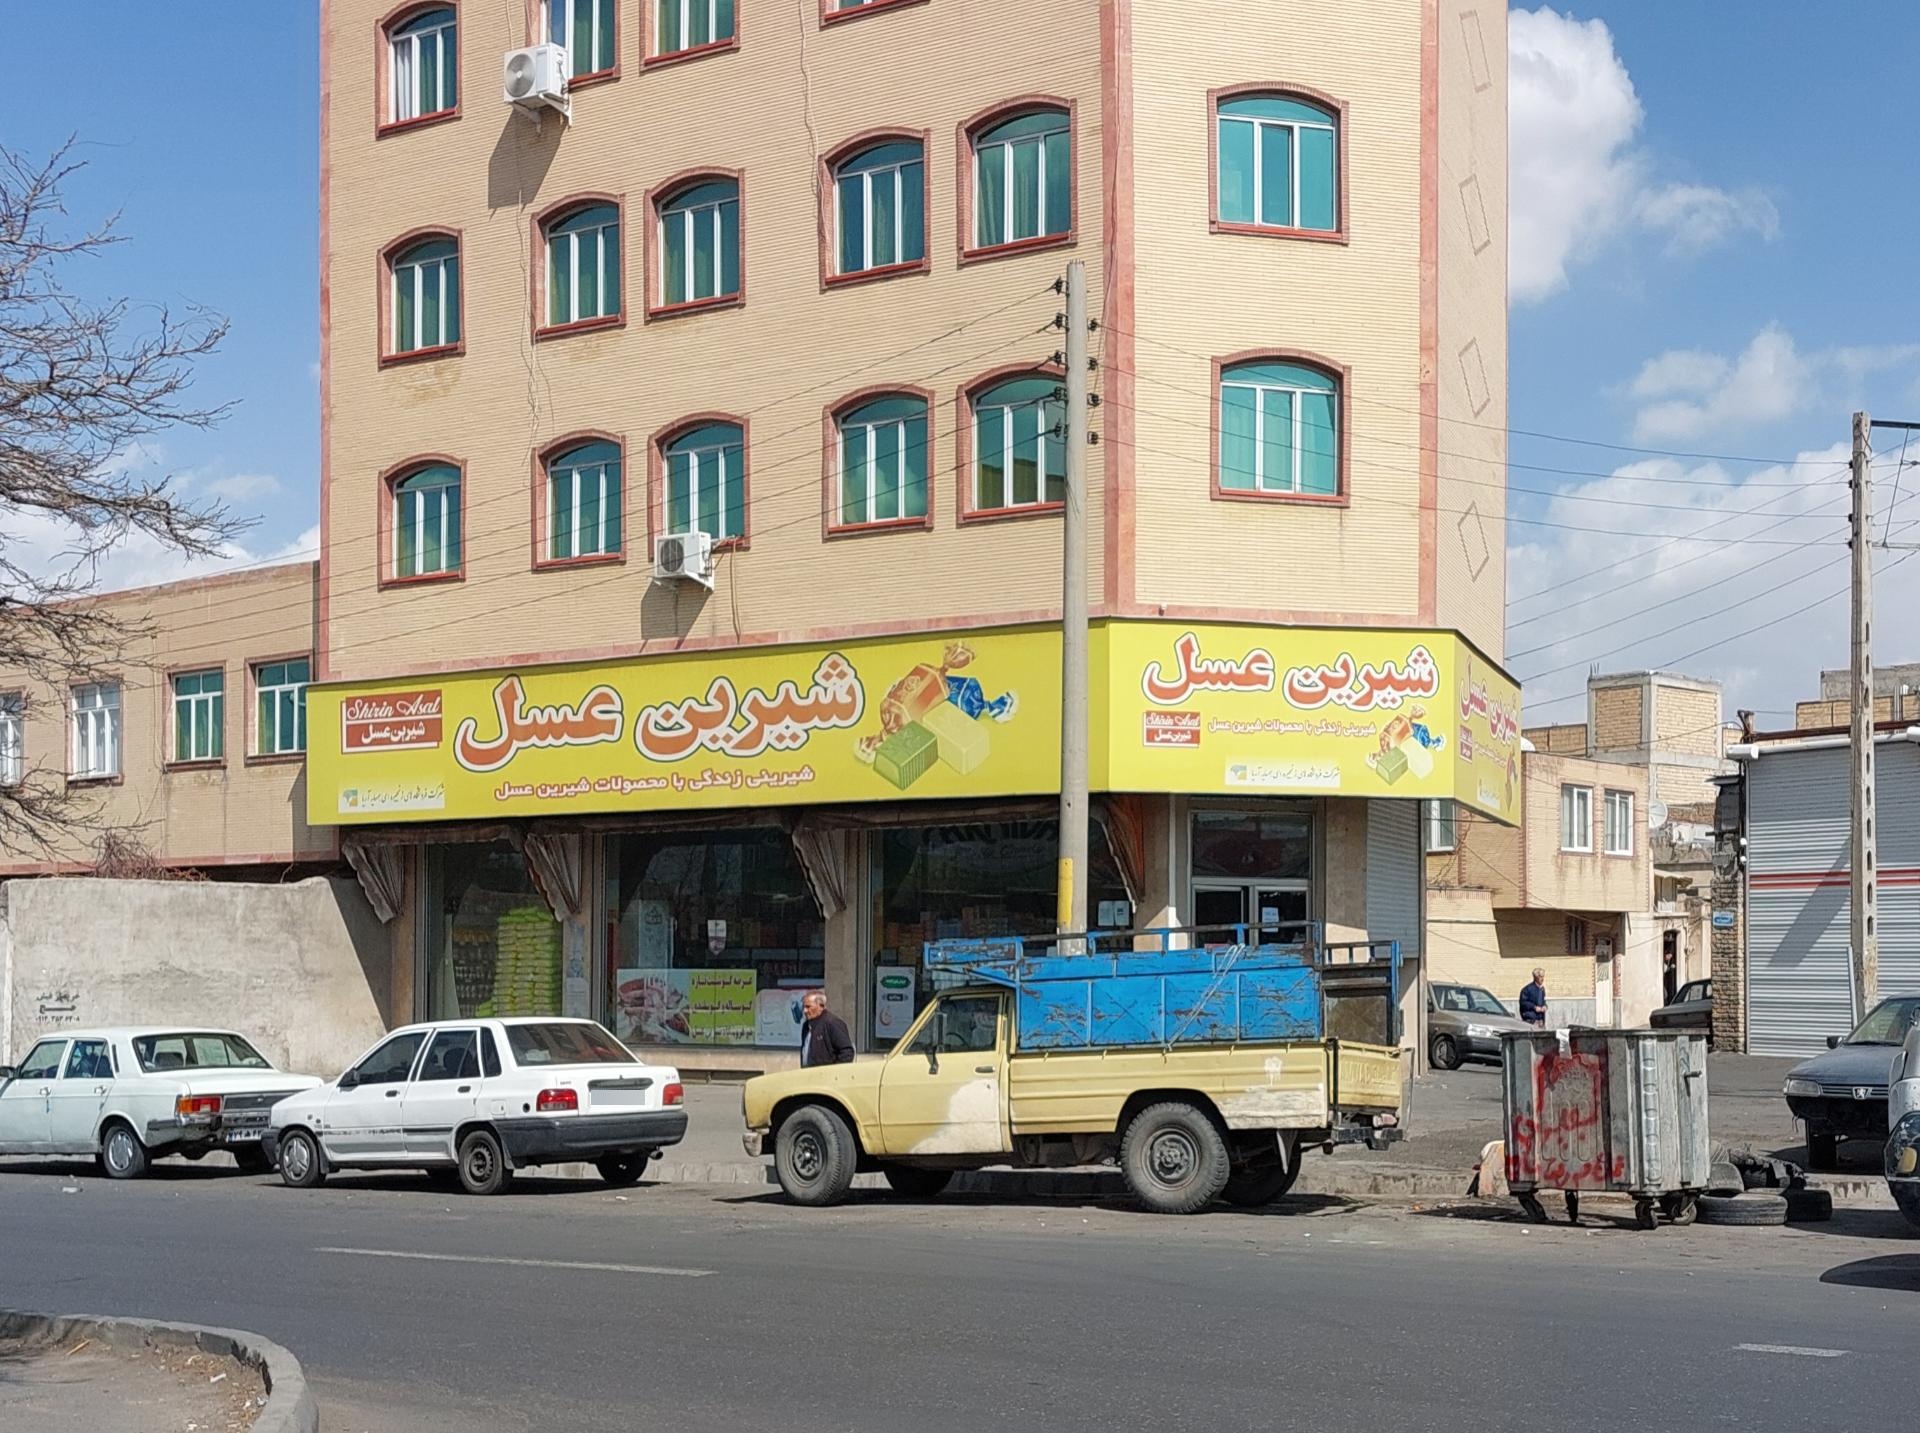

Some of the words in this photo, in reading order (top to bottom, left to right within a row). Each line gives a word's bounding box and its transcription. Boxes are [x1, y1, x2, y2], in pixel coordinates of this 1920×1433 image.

[1141, 630, 1275, 706] عسل
[1282, 643, 1440, 712] شیرین
[1459, 654, 1488, 721] عسل
[347, 699, 394, 720] Shirin
[396, 693, 441, 716] Asal
[634, 652, 864, 762] شیرین
[390, 721, 425, 742] شیرین
[454, 673, 623, 773] عسل
[1208, 717, 1231, 733] عسل
[1232, 718, 1262, 733] شیرین
[1264, 719, 1304, 734] محصولات
[1305, 720, 1313, 735] با
[1314, 719, 1343, 736] زندگی
[1343, 722, 1376, 737] شیرینی
[361, 723, 391, 745] عسل
[594, 776, 667, 795] محصولات
[671, 772, 685, 791] با
[689, 769, 743, 791] زندگی
[745, 765, 814, 787] شیرینی
[495, 782, 534, 801] عسل
[536, 778, 590, 799] شیرین
